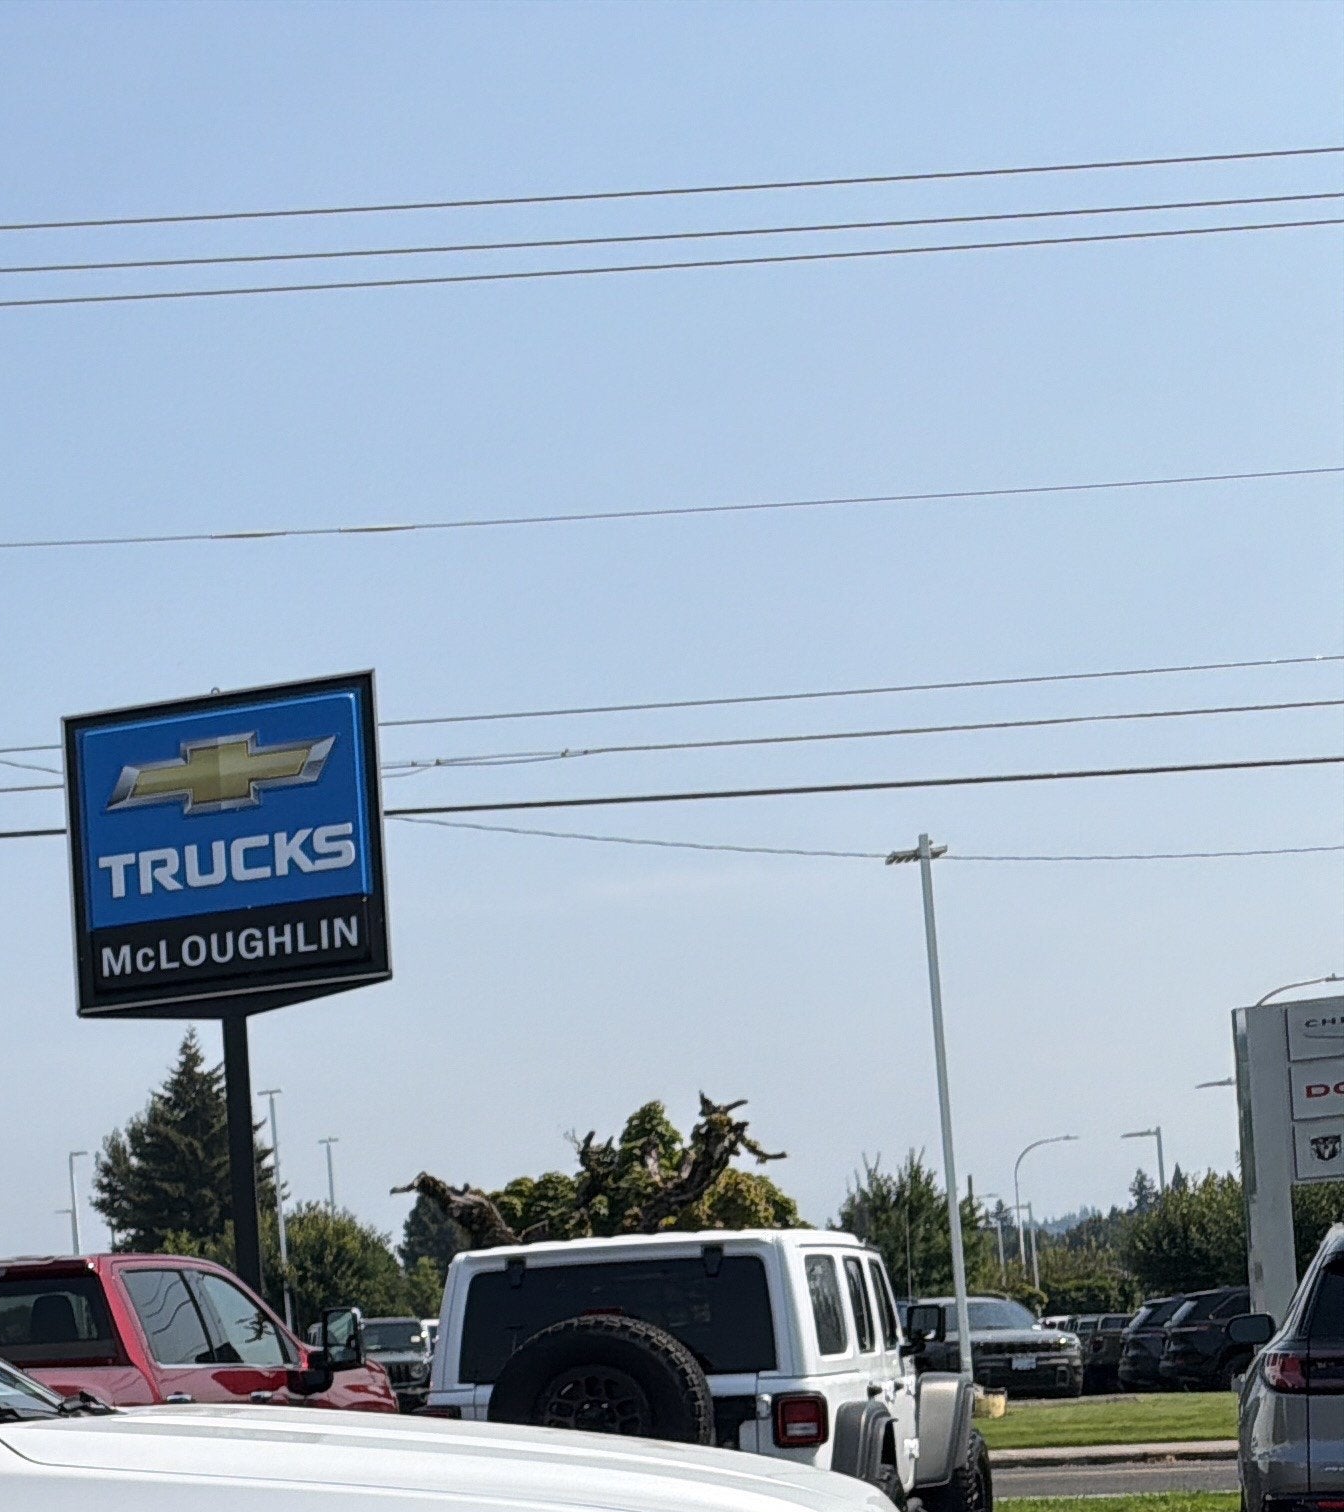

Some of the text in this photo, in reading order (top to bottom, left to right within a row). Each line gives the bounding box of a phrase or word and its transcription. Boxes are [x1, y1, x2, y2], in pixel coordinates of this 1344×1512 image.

[99, 823, 355, 896] TRUCKS
[101, 916, 358, 978] McLOUGHLIN
[1305, 1016, 1344, 1027] CH
